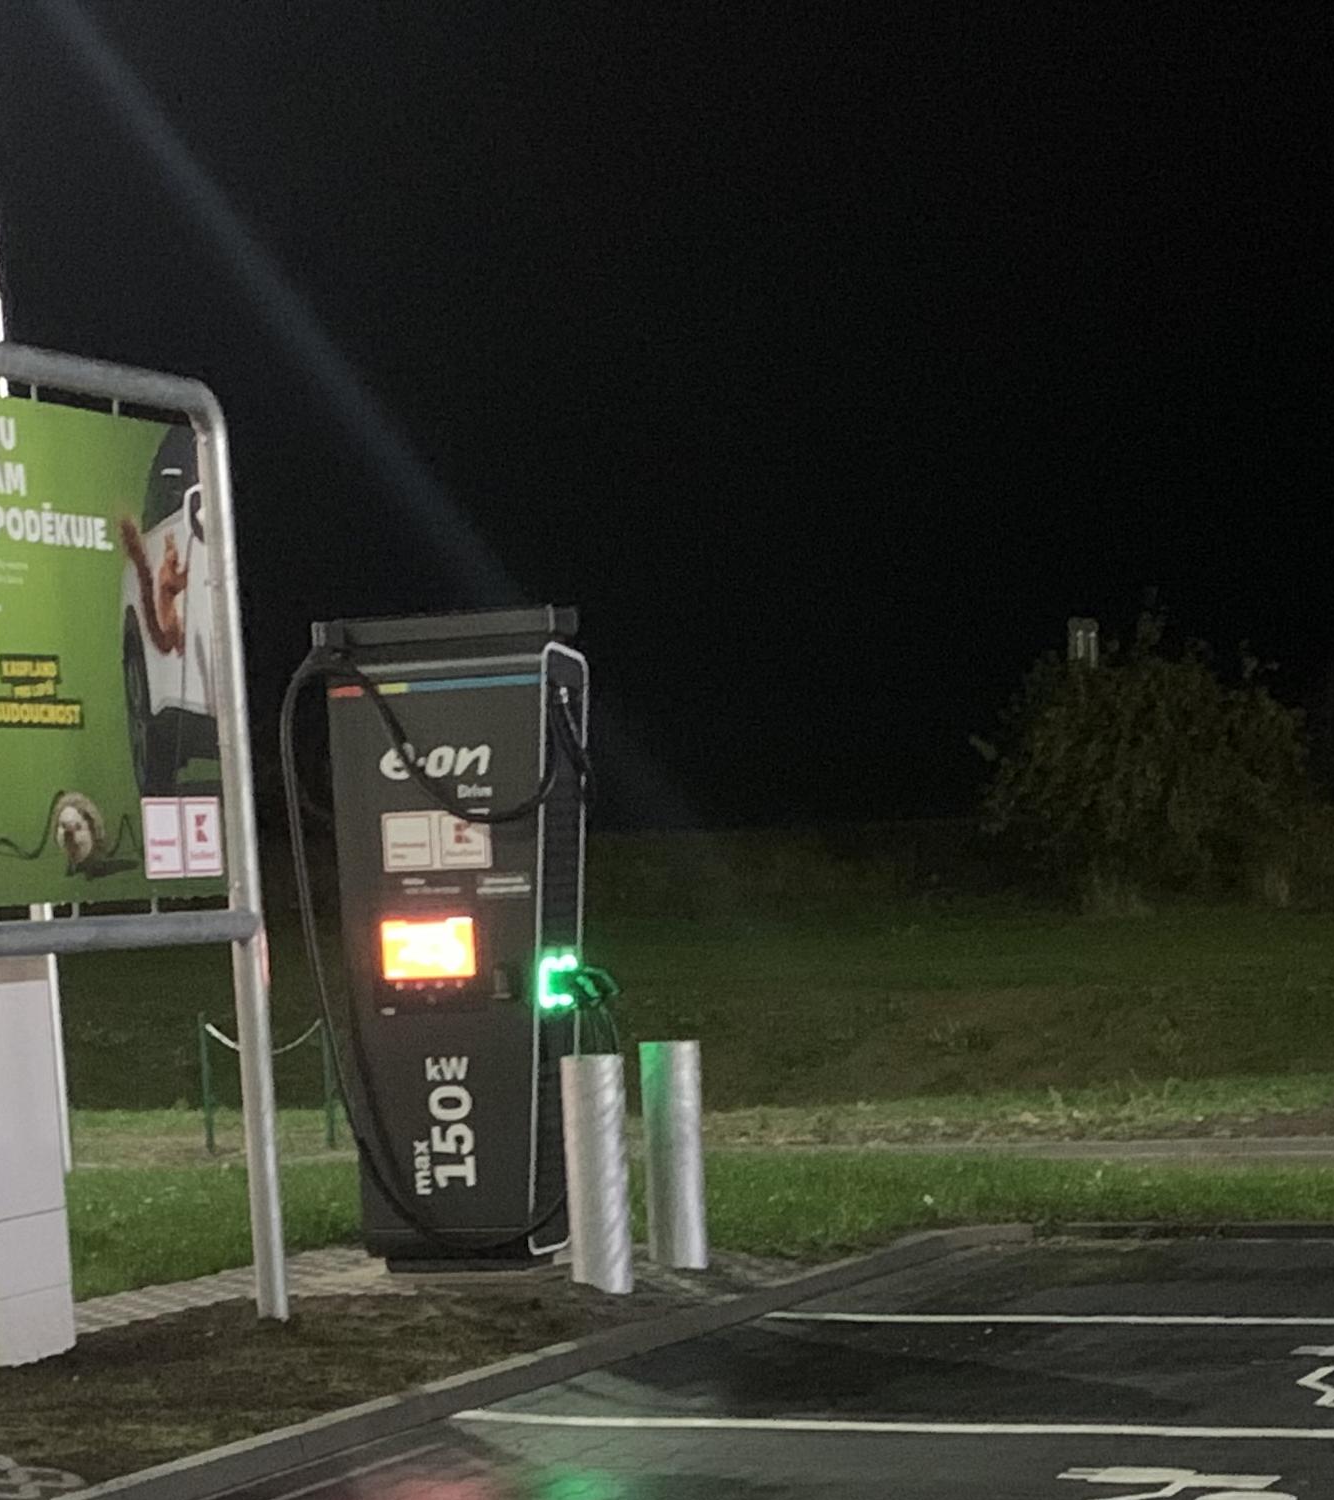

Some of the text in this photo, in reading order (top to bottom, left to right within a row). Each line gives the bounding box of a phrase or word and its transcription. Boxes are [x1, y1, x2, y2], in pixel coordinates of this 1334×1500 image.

[425, 1056, 469, 1082] kW
[428, 1085, 477, 1188] 150
[413, 1140, 433, 1196] max
